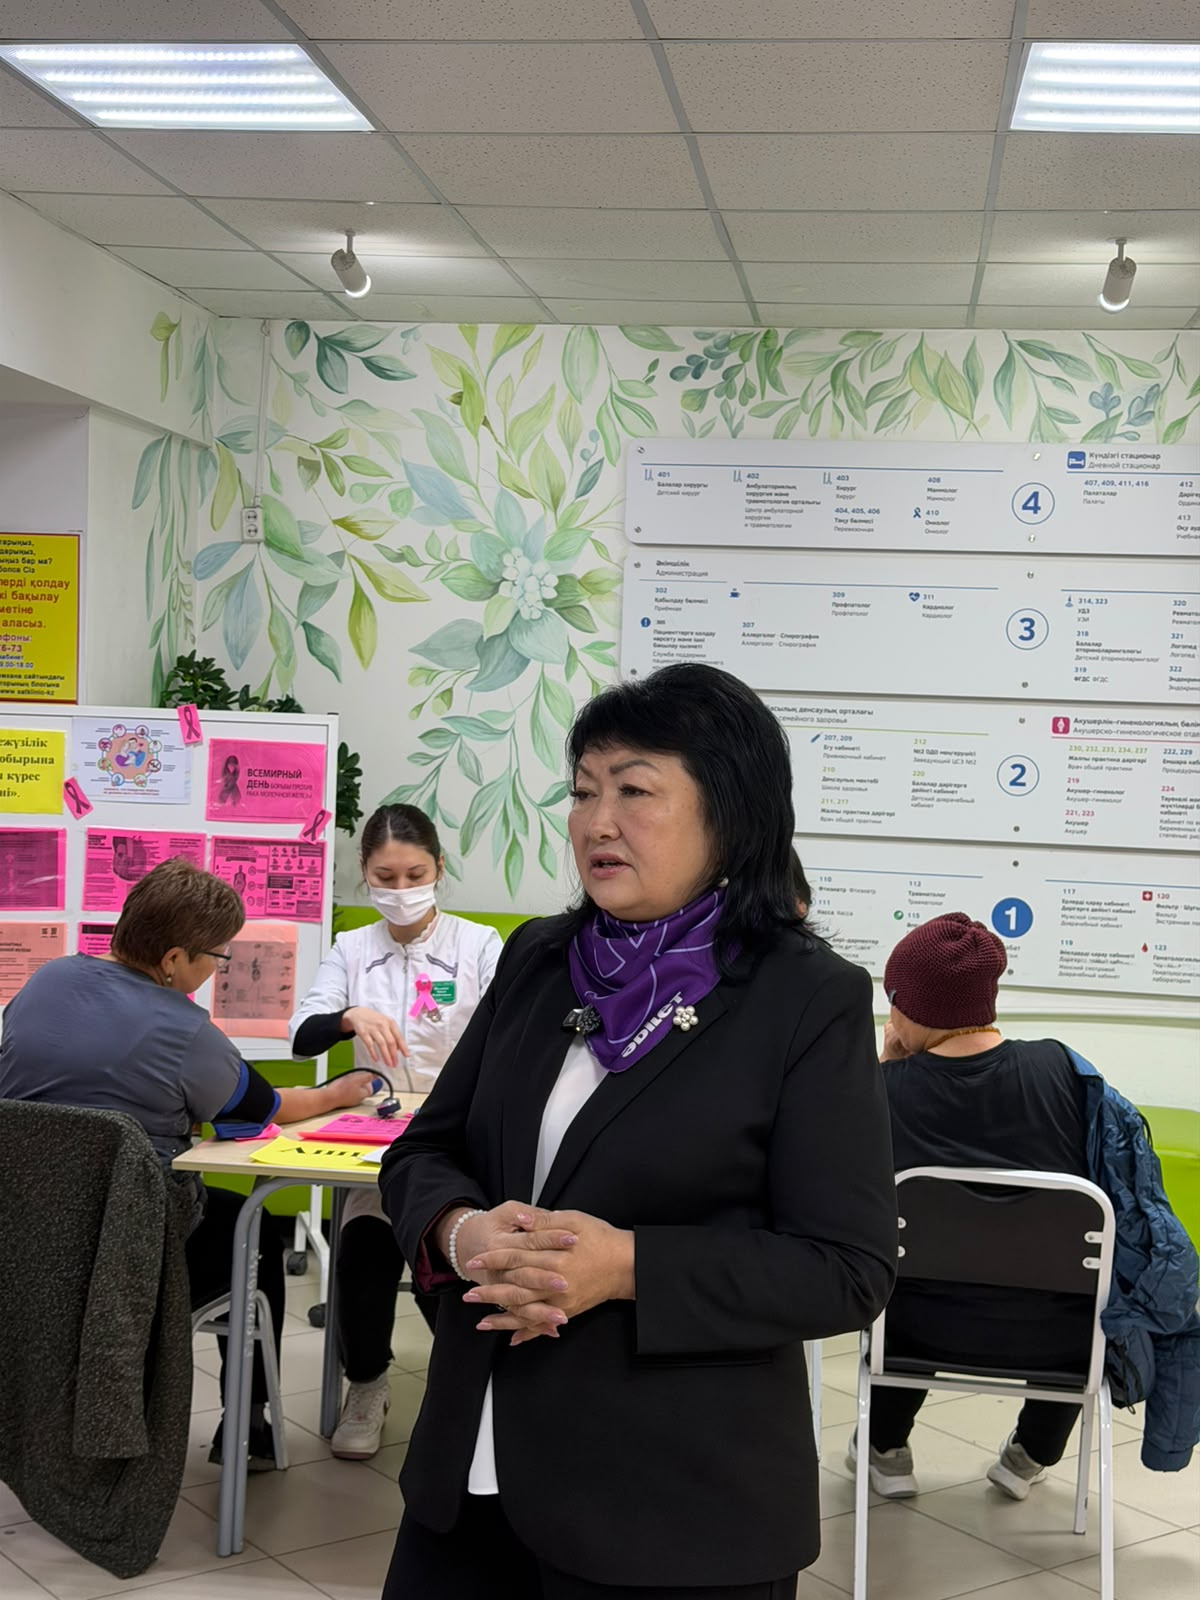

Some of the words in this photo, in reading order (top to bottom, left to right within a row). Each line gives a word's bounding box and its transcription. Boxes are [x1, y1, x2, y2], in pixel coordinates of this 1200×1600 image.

[1121, 452, 1161, 461] стационар
[1121, 462, 1160, 470] стационар
[1021, 490, 1041, 515] 4
[30, 580, 70, 590] қолдау
[11, 590, 59, 603] бақылау
[2, 620, 46, 628] аласыз.
[1018, 617, 1036, 641] 3
[6, 772, 40, 782] күрес
[247, 767, 302, 779] ВСЕМИРНЫЙ
[1009, 763, 1027, 786] 2
[246, 780, 270, 790] ДЕНЬ
[1004, 906, 1017, 931] 1
